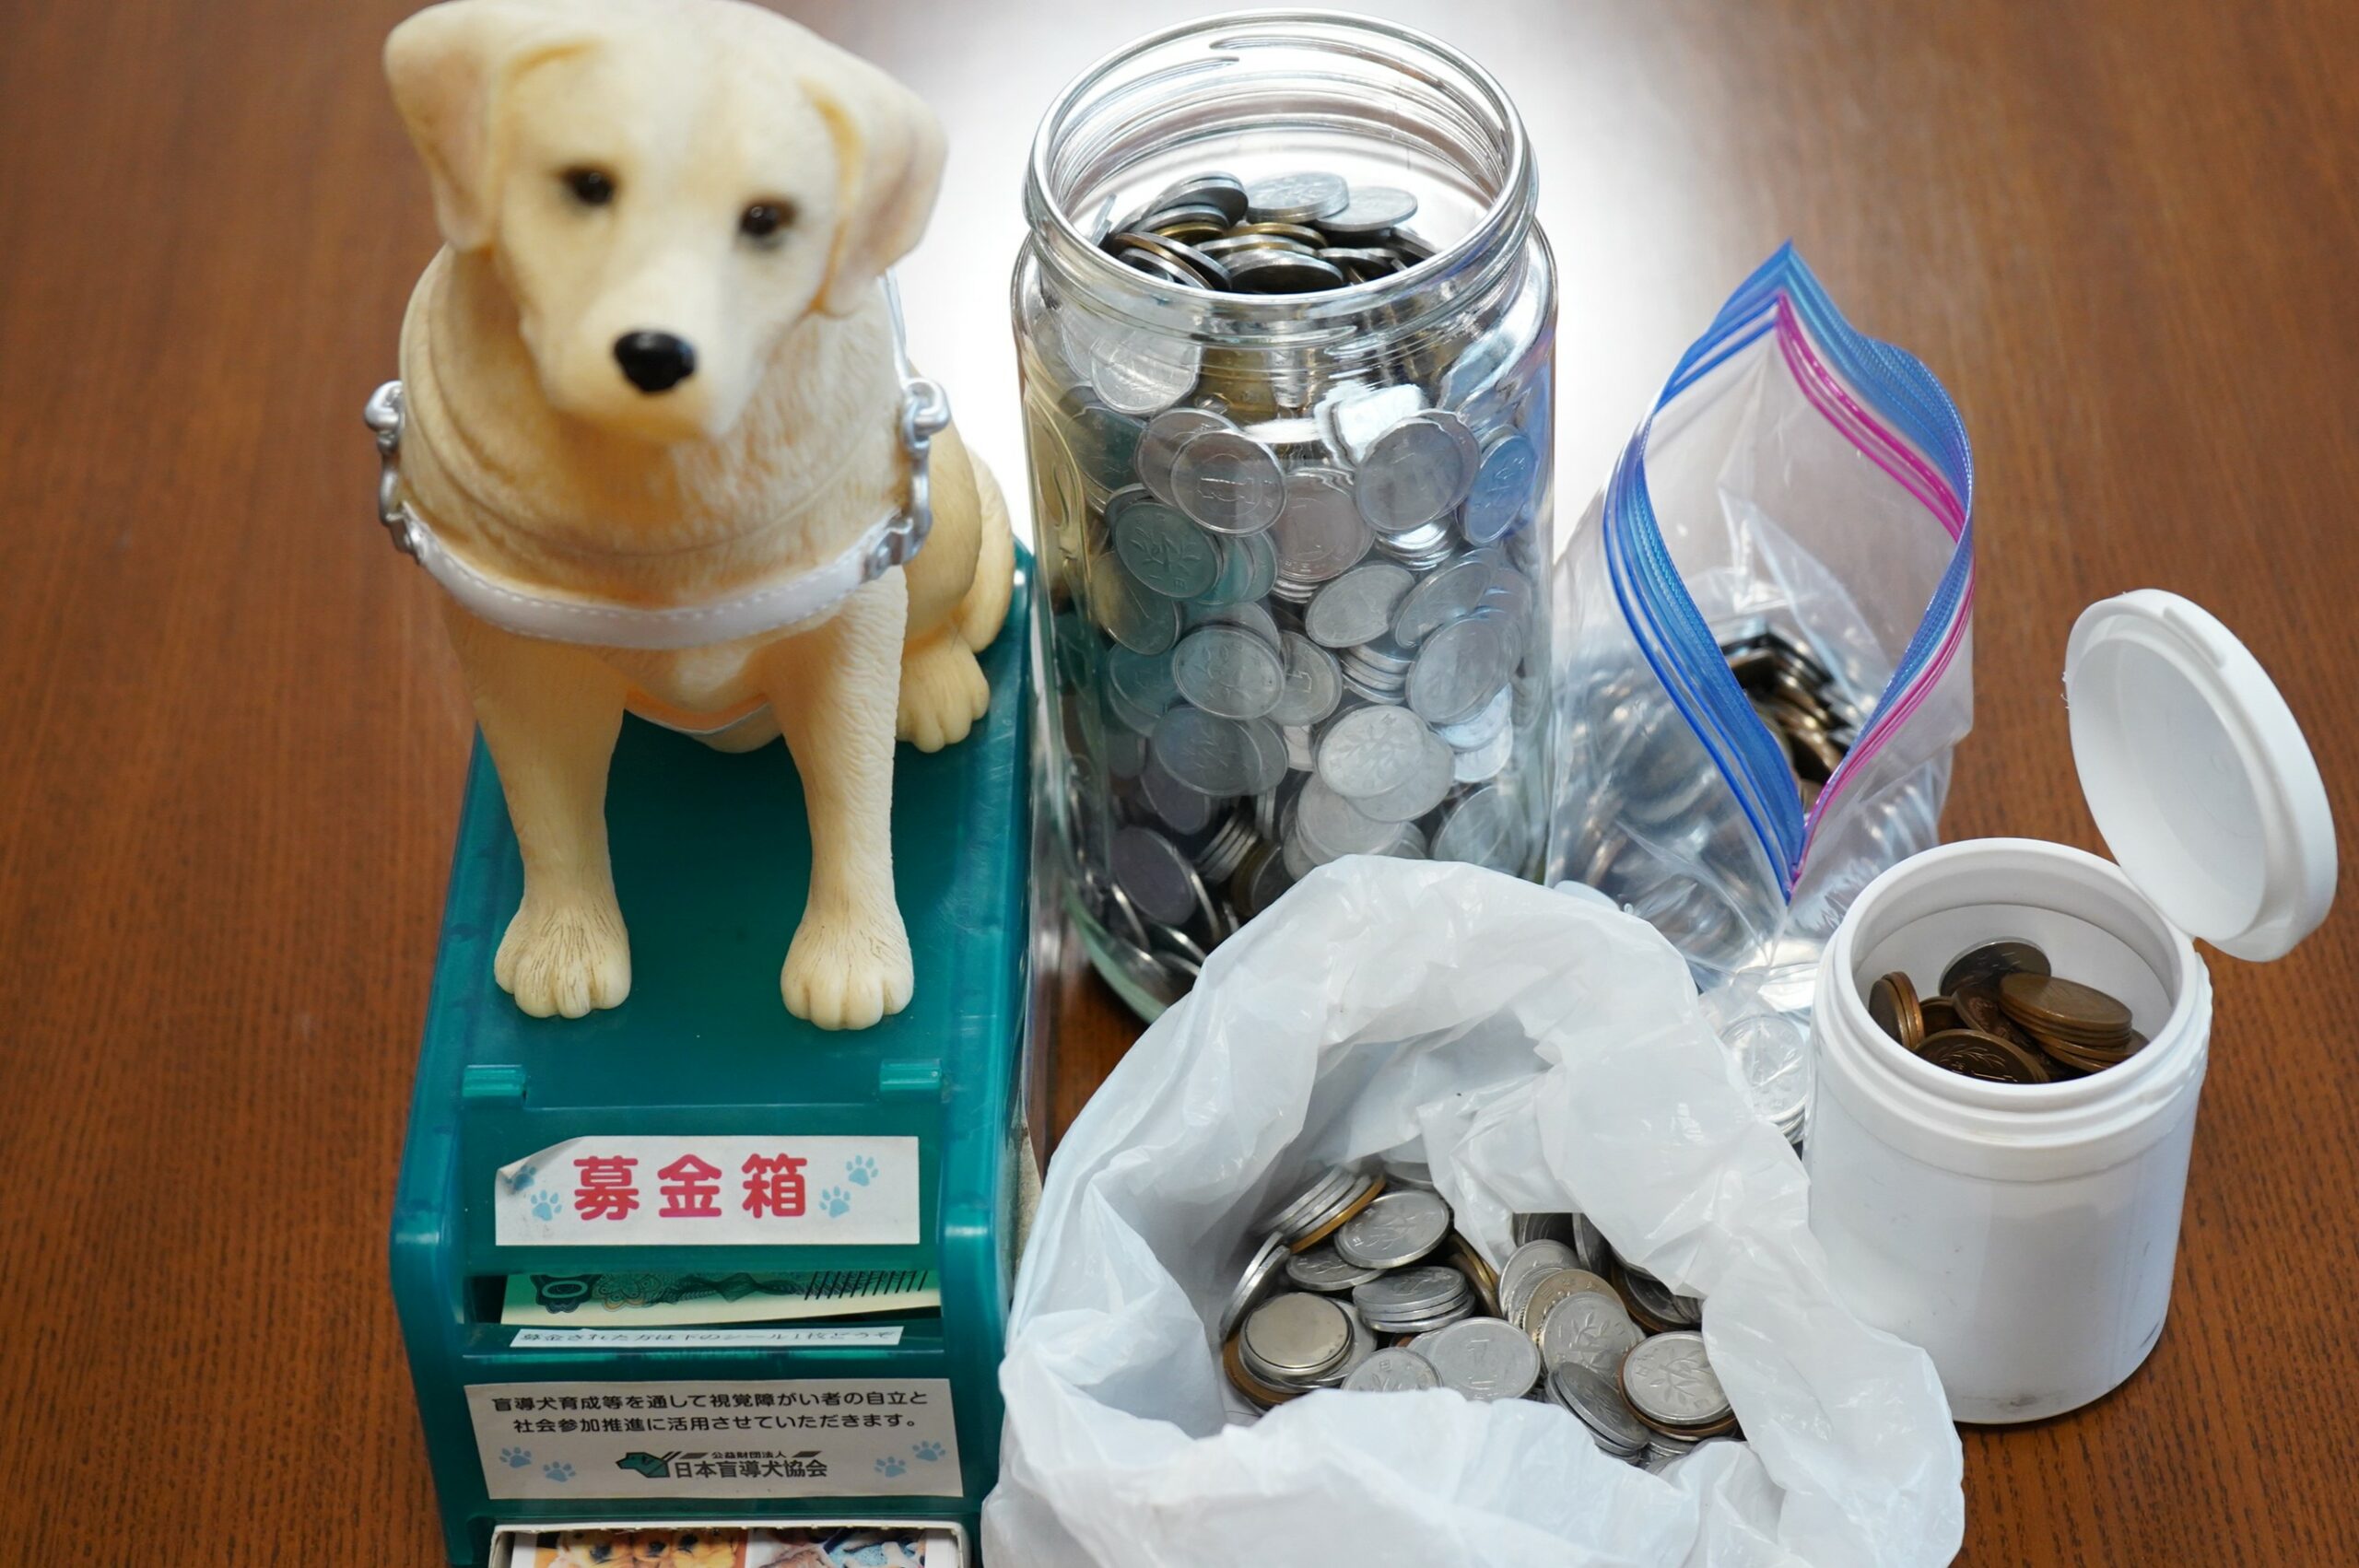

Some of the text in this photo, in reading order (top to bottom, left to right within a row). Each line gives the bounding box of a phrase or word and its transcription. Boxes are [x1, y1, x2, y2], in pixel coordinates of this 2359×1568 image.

[573, 1153, 808, 1221] 募金箱
[491, 1390, 929, 1411] 盲導犬育成等を通して視覚障がい者の自立と
[512, 1412, 916, 1433] 社会参加推進に活用させていただきます。
[710, 1451, 787, 1459] 公益財団法人
[674, 1459, 828, 1479] 日本盲導犬協会
